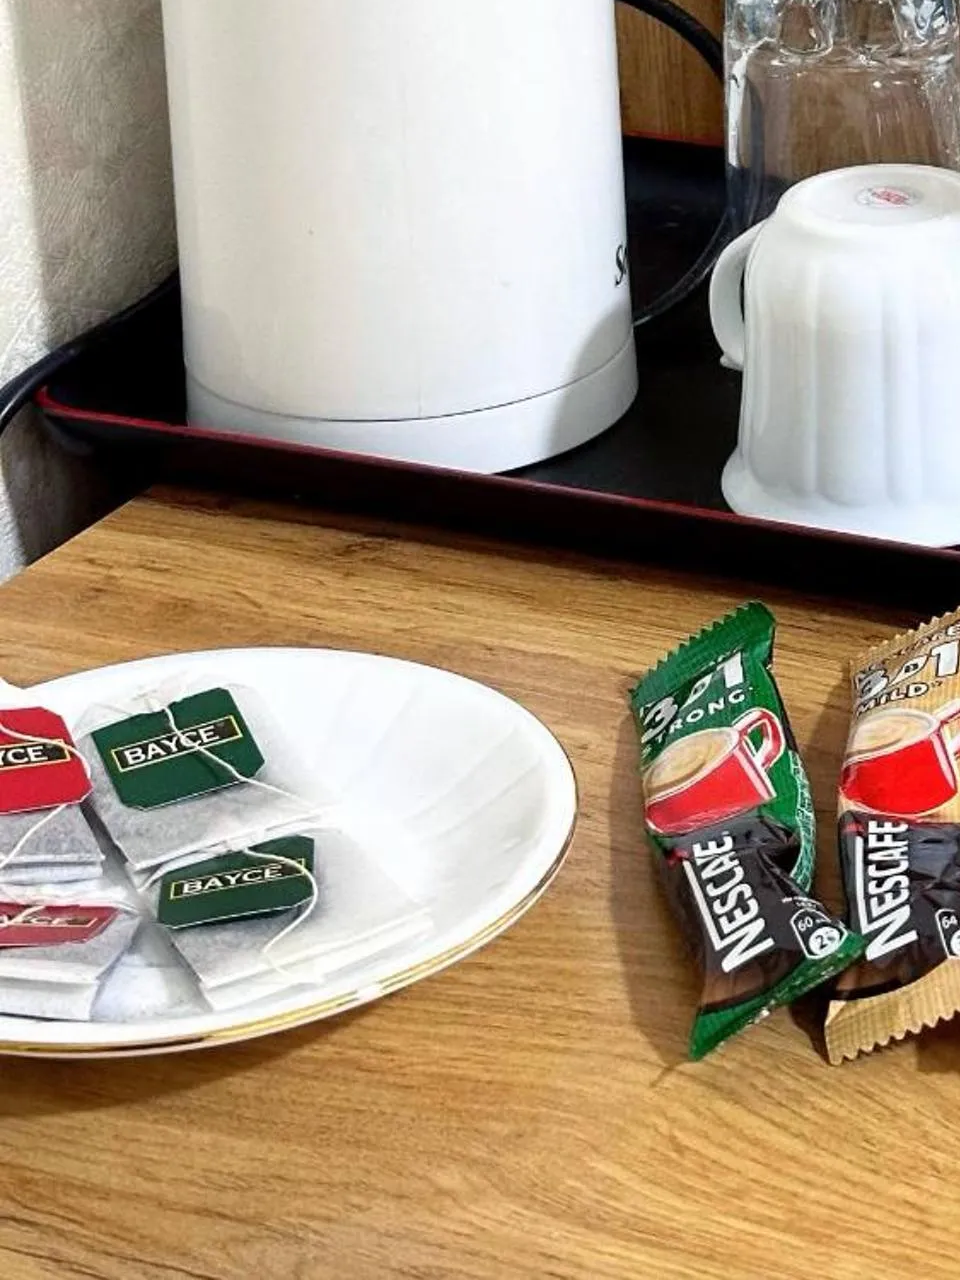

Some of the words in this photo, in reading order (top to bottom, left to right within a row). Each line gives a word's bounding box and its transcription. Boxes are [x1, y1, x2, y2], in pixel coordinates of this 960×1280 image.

[0, 745, 46, 764] YCE
[123, 726, 221, 766] BAYCE
[181, 864, 283, 896] BAYCE
